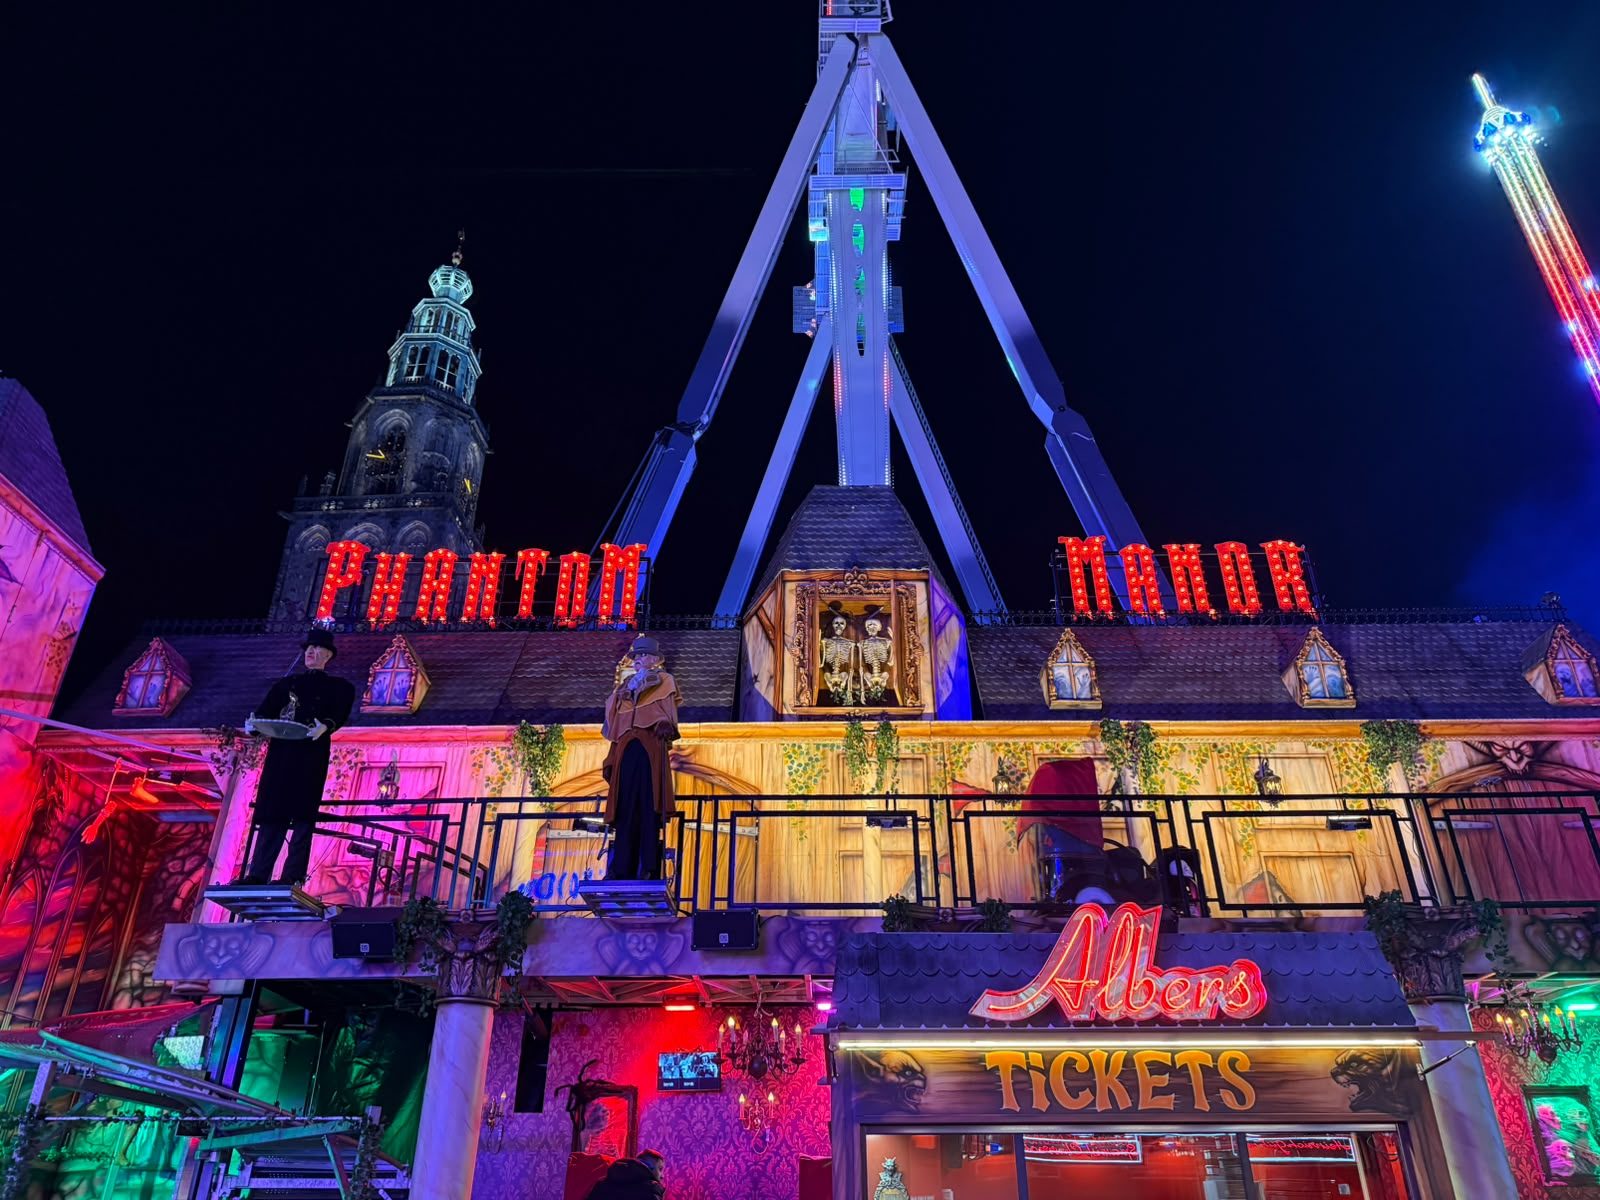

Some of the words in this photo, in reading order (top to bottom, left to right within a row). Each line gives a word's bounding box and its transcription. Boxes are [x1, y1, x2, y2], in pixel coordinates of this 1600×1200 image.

[316, 540, 647, 628] PHANTOM
[1058, 535, 1316, 620] MANOR
[968, 902, 1267, 1021] Albers
